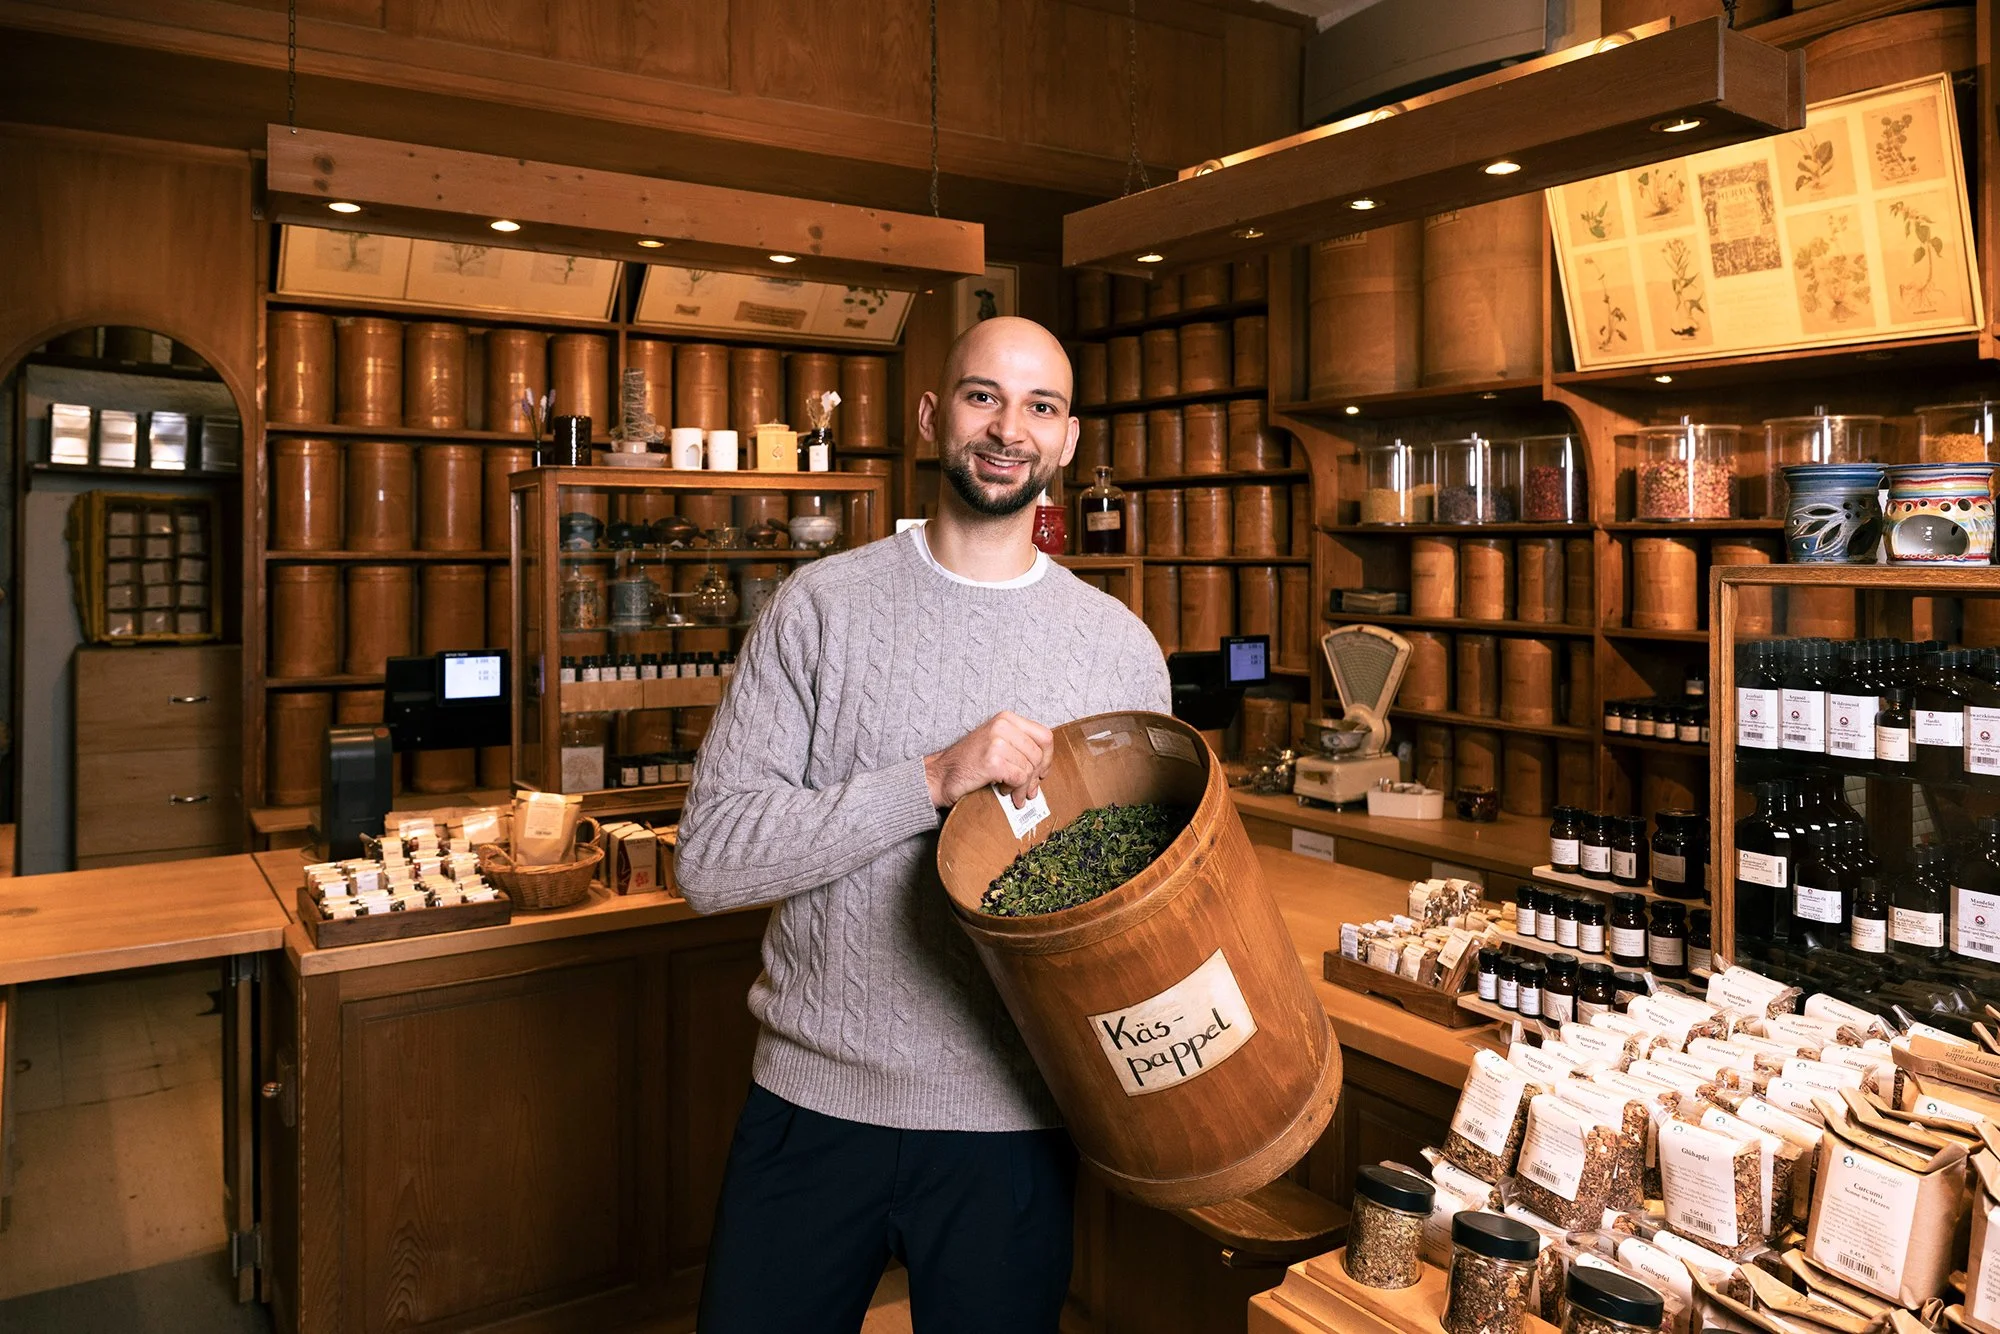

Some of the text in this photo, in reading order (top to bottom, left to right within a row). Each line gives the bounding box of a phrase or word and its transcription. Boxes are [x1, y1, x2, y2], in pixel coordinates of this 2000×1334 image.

[1102, 1015, 1184, 1051] Käs-
[1575, 1034, 1607, 1047] Winterfrucht
[1126, 1007, 1232, 1087] pappel
[1524, 1053, 1553, 1071] Winterfrucht
[1681, 1147, 1710, 1162] Glühapfel
[1853, 1182, 1884, 1200] Curcumi
[1640, 1262, 1670, 1283] Glühapfel
